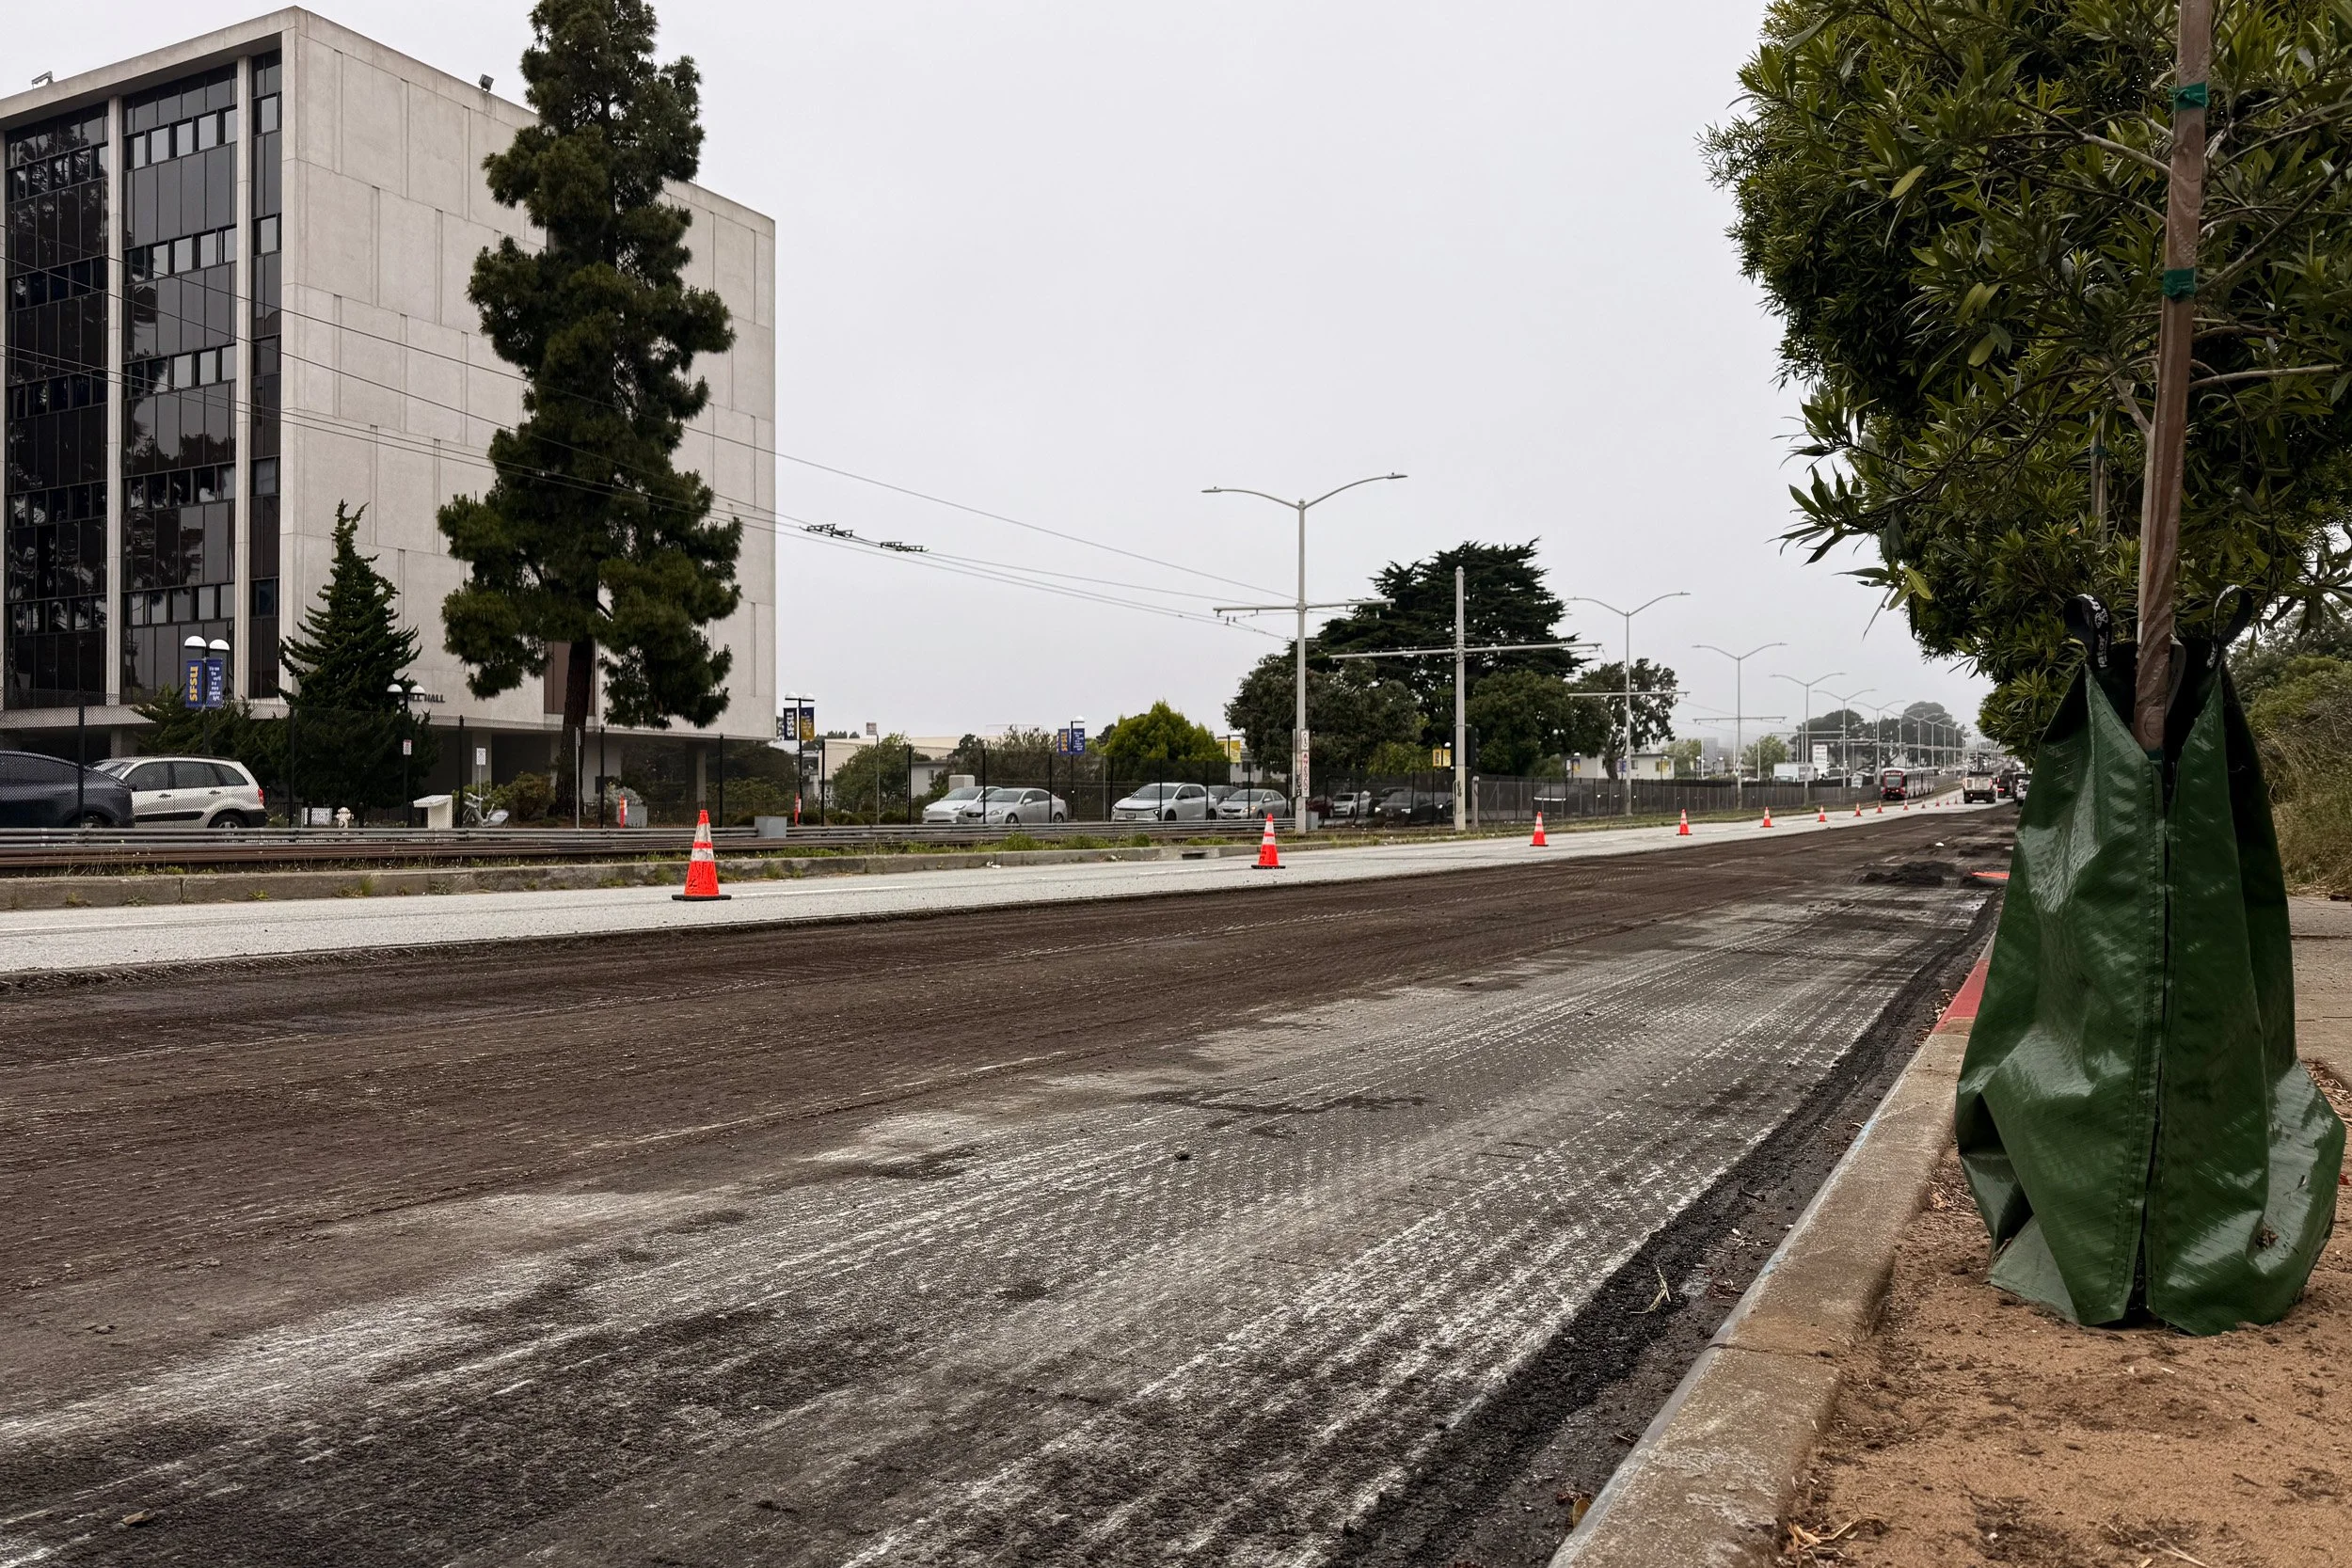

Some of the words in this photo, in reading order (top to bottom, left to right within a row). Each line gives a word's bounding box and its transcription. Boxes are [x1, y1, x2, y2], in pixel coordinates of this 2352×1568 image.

[189, 666, 199, 702] SFSU
[424, 693, 446, 703] HALL
[787, 711, 795, 737] SFSU
